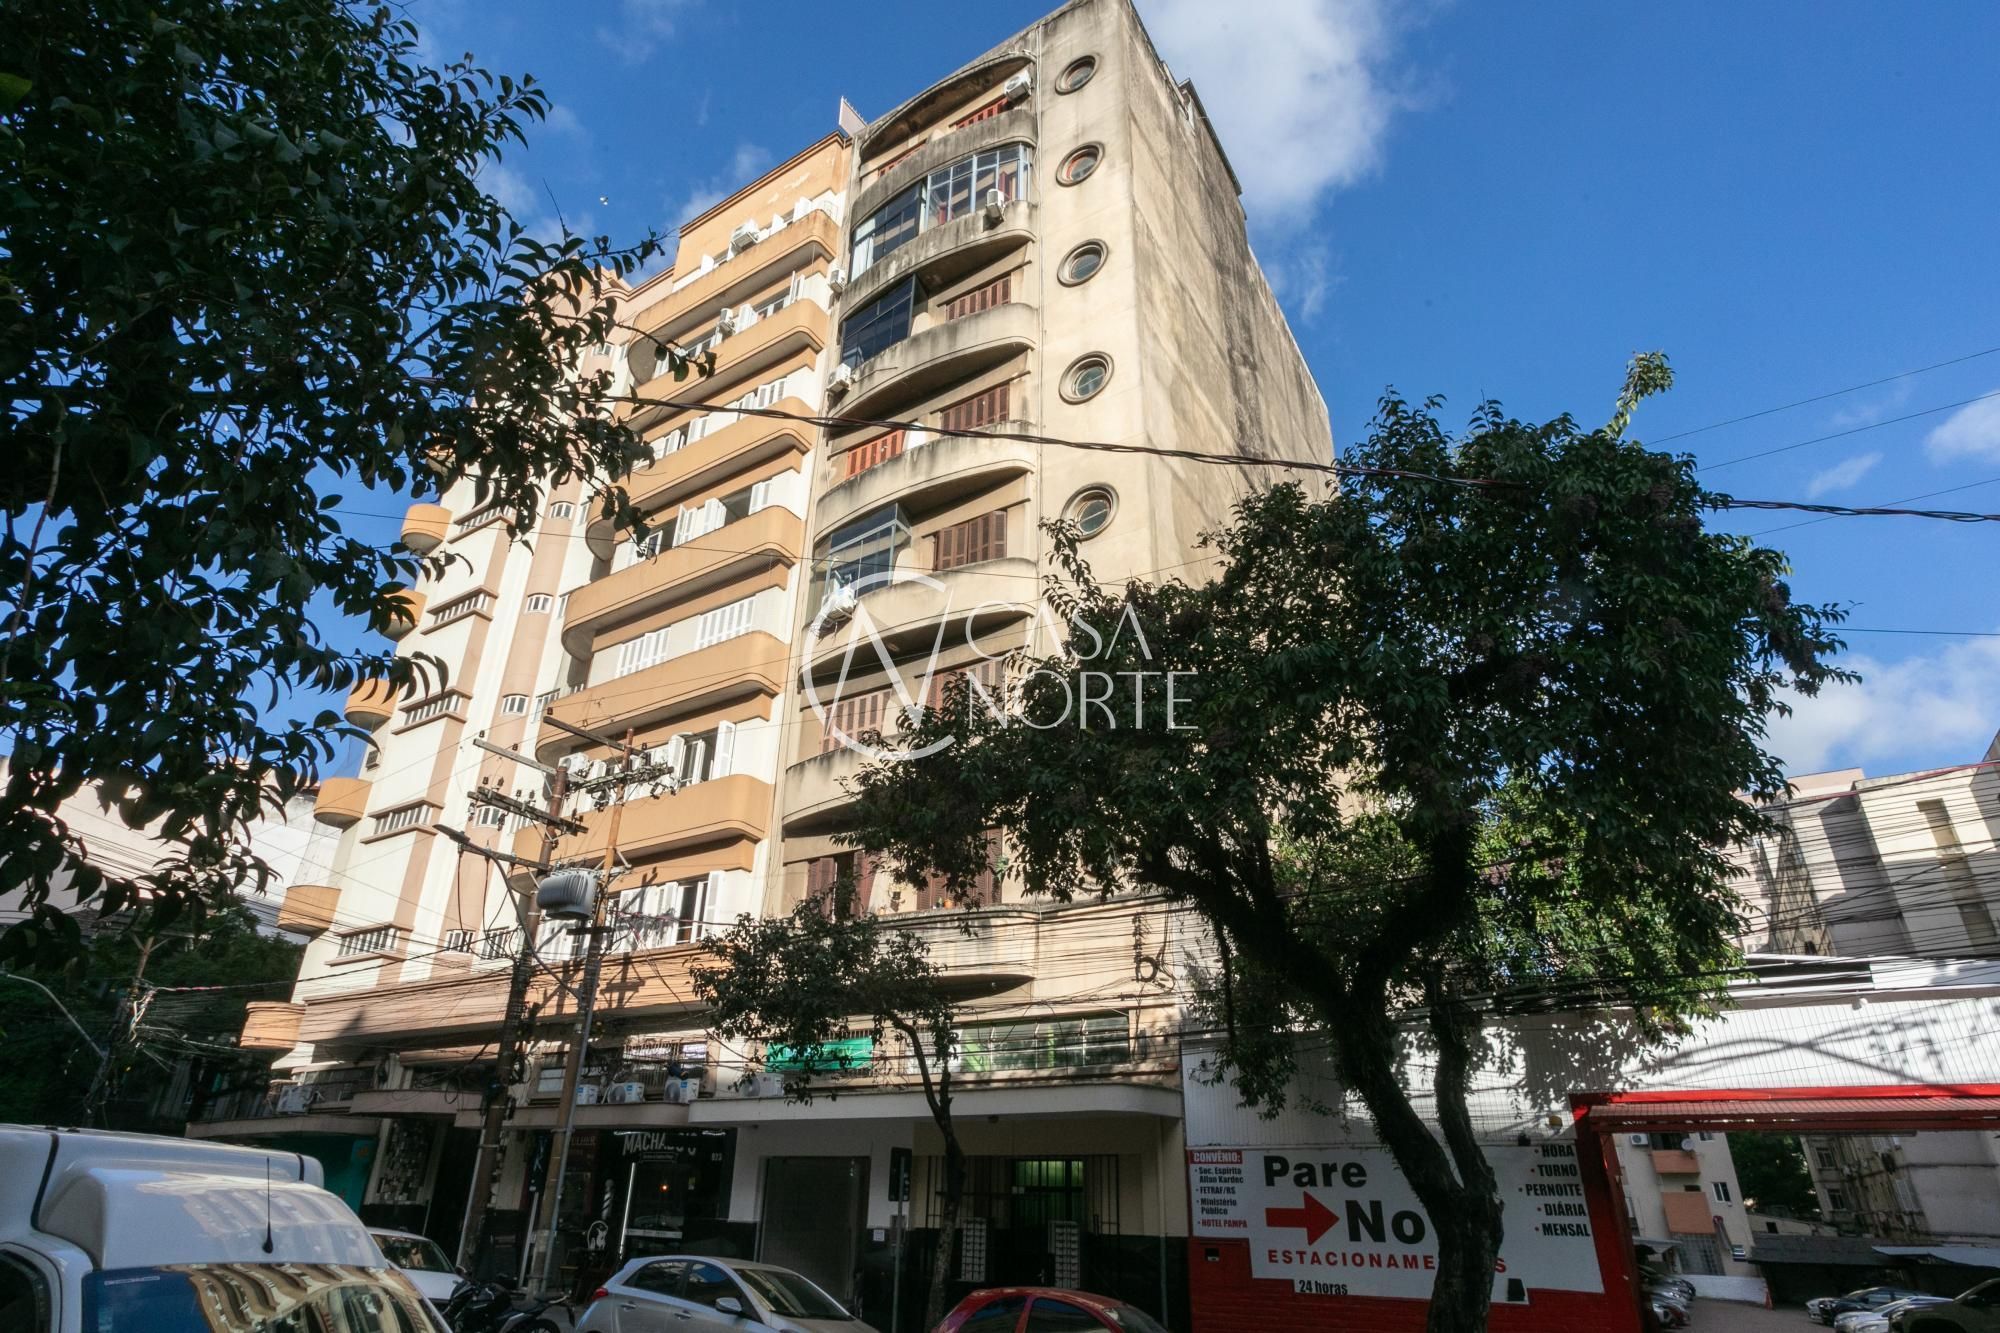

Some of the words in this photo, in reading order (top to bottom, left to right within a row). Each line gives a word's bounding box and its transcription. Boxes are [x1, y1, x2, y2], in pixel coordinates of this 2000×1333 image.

[1541, 1144, 1575, 1157] HORA
[1263, 1155, 1367, 1188] Pare
[1537, 1164, 1578, 1176] TURNO
[1525, 1184, 1582, 1196] PERNOITE
[1544, 1201, 1586, 1216] DIÁRIA
[1542, 1223, 1590, 1237] MENSAL
[1268, 1249, 1507, 1273] ESTACIONAMES
[1299, 1280, 1313, 1293] 24
[1314, 1280, 1348, 1295] horas
